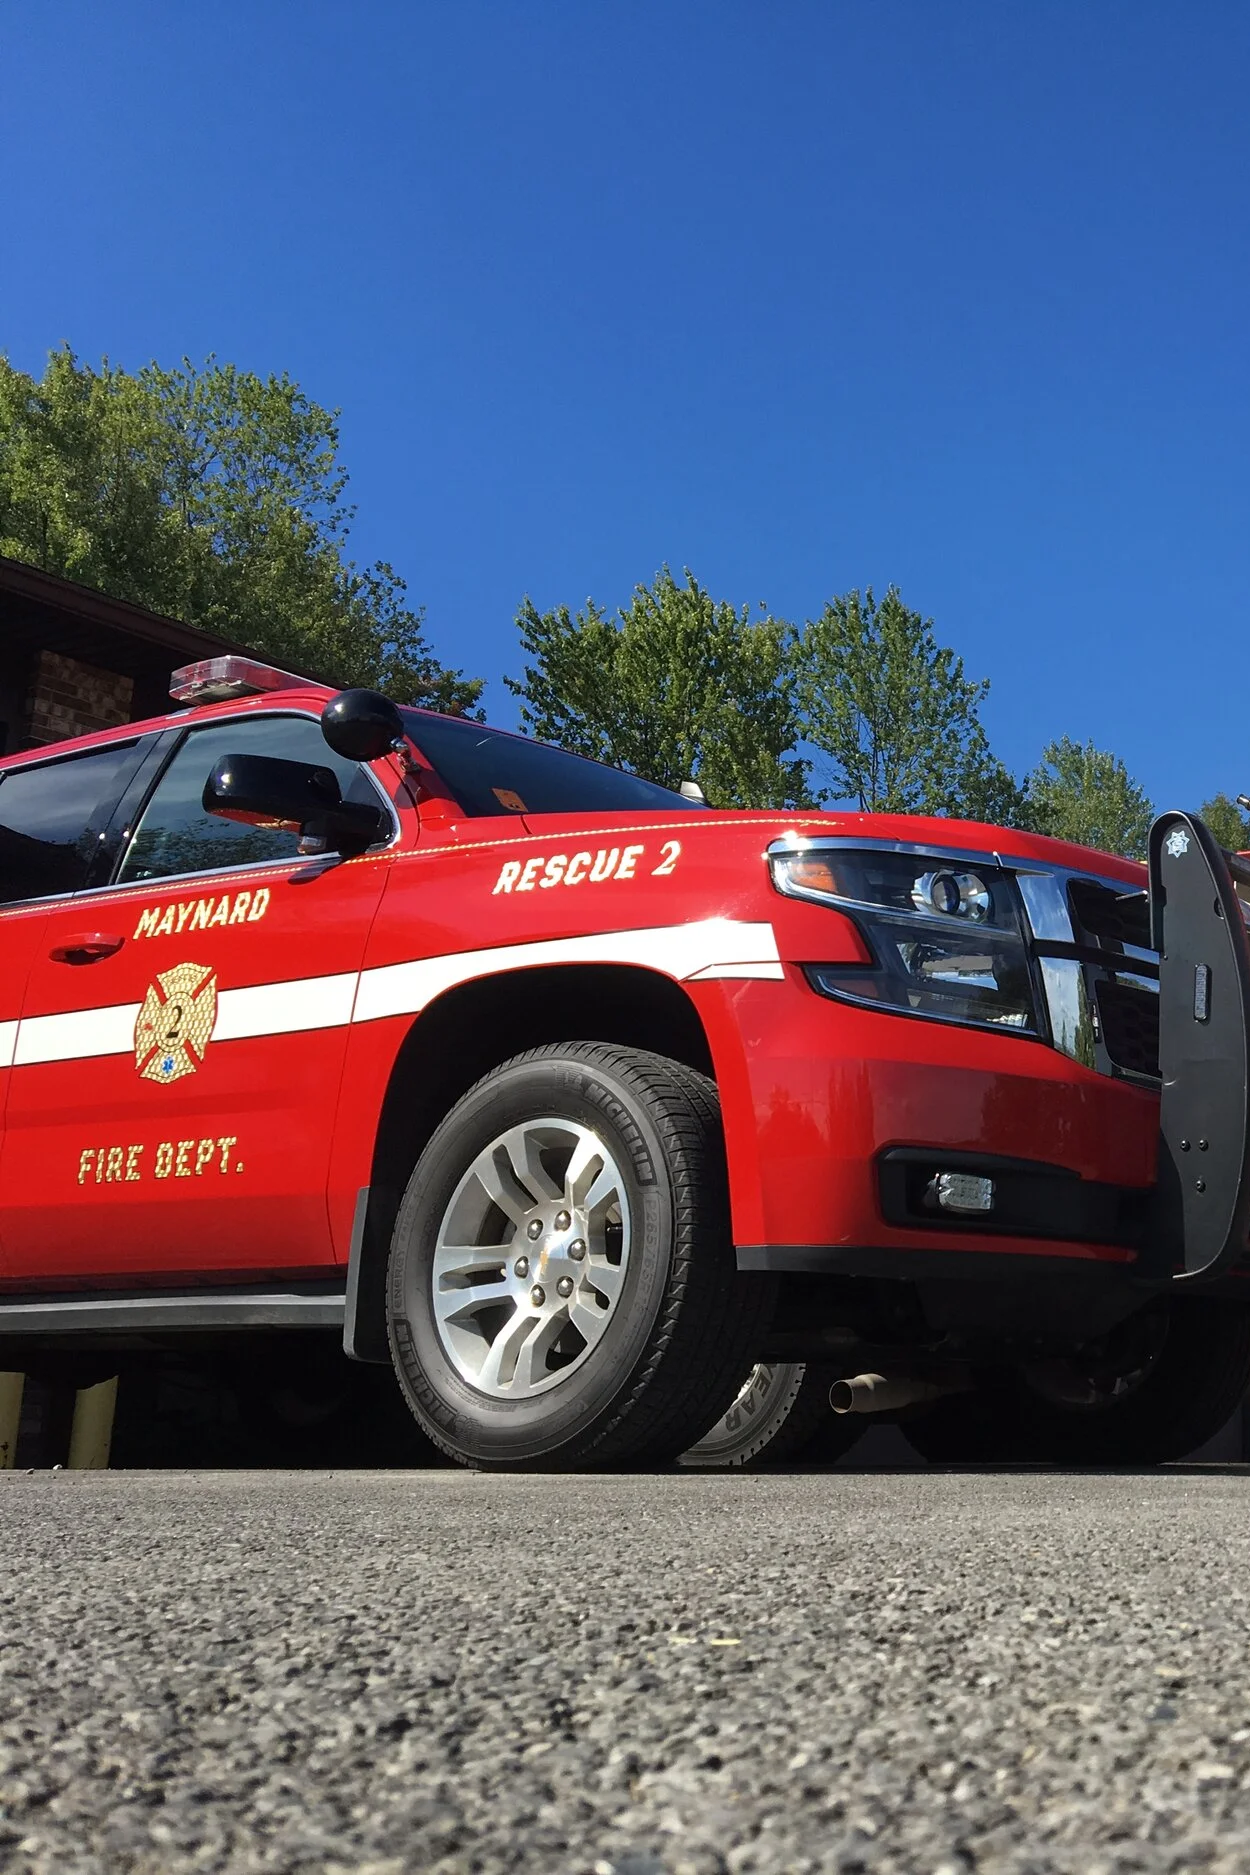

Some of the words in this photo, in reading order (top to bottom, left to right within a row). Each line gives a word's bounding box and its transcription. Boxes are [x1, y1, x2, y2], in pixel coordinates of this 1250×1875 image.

[493, 845, 645, 895] RESCUE
[651, 840, 682, 876] 2
[133, 888, 270, 940] MAYNARD
[166, 1004, 183, 1039] 2
[584, 1082, 654, 1182] MICHELIN
[78, 1145, 144, 1184] FIRE
[155, 1137, 244, 1179] DEPT.
